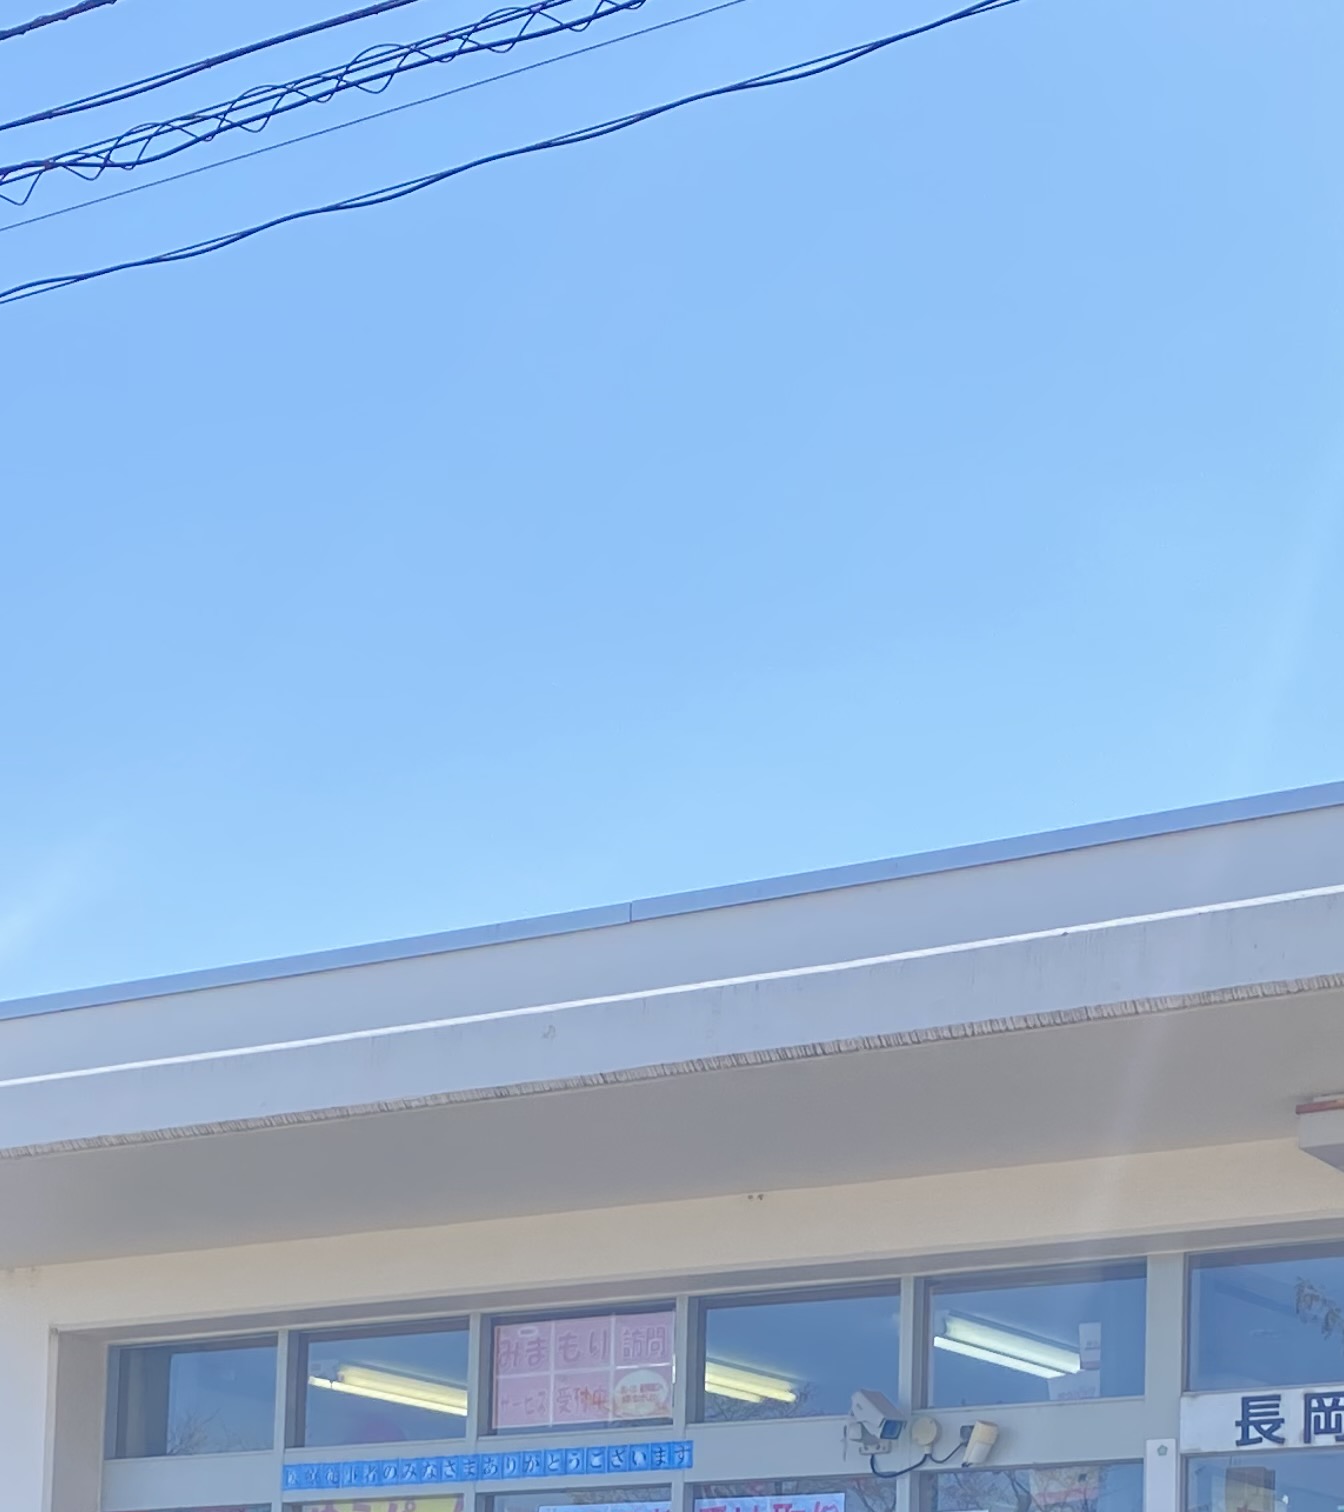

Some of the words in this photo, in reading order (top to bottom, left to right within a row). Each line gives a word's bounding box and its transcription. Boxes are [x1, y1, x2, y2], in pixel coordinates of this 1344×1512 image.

[499, 1326, 666, 1369] みまもり訪問
